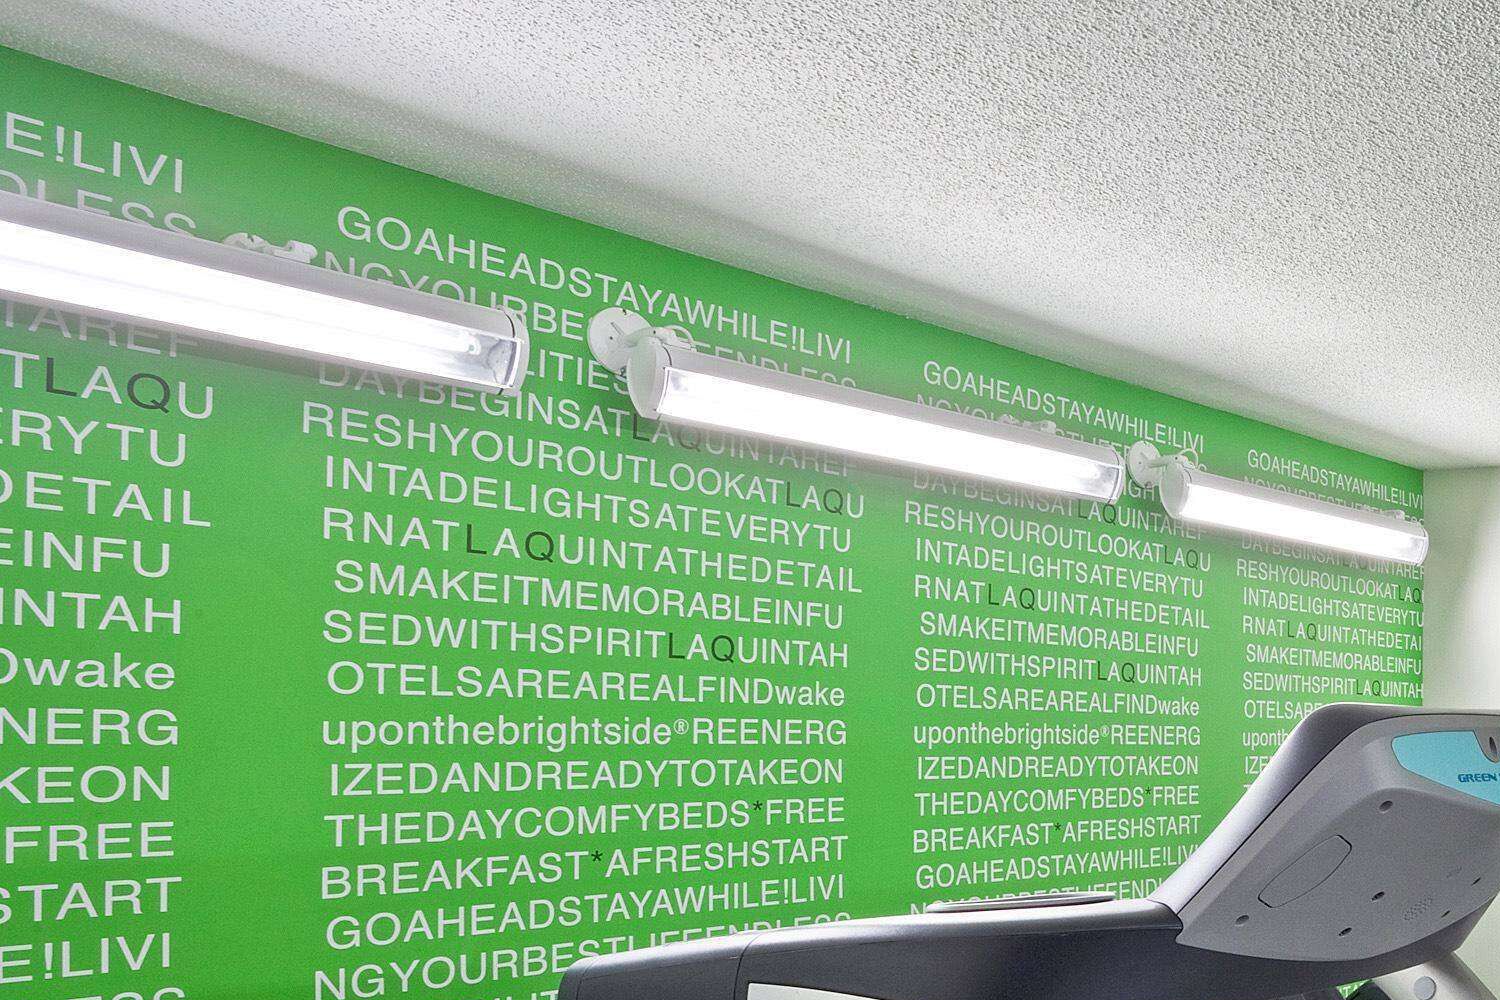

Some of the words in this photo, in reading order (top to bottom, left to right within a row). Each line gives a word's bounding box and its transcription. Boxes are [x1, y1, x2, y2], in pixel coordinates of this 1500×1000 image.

[4, 110, 186, 195] E!LIVI
[337, 204, 853, 365] GOAHEADSTAYAWHILE!LIVI
[0, 347, 214, 420] TLAQU
[923, 360, 1204, 454] GOAHEADSTAYAWHILE!LIVI
[0, 408, 187, 468] RYTU
[302, 400, 866, 520] RESHYOUROUTLOOKATLAQU
[325, 455, 852, 553] INTADELIGHTSATEVERYTU
[322, 506, 862, 594] RNATLAQUINTATHEDETAIL
[916, 537, 1204, 599] INTADELIGHTSATEVERYTU
[334, 559, 844, 631] SMAKEITMEMORABLEINFU
[913, 574, 1210, 630] RNATLAQUINTATHEDETAIL
[1236, 558, 1424, 604] RESHYOUROUTLOOKATLAQ
[322, 609, 848, 668] SEDWITHSPIRITLAQUINTAH
[919, 611, 1199, 658] SMAKEITMEMORABLEINFU
[326, 660, 846, 708] OTELSAREAREALFINDwake
[913, 646, 1202, 687] SEDWITHSPIRITLAQUINTAH
[0, 706, 179, 746] NERG
[915, 683, 1200, 717] OTELSAREAREALFINDwake
[0, 766, 171, 804] KEON
[330, 758, 844, 796] IZEDANDREADYTOTAKEON
[916, 755, 1199, 780] IZEDANDREADYTOTAKEON
[1457, 771, 1497, 783] GREEN
[4, 821, 175, 864] FREE
[915, 844, 1199, 890] GOAHEADSTAYAWHILE!LIV
[325, 873, 845, 950] GOAHEADSTAYAWHILE!LIVI
[0, 932, 171, 984] E!LIVI
